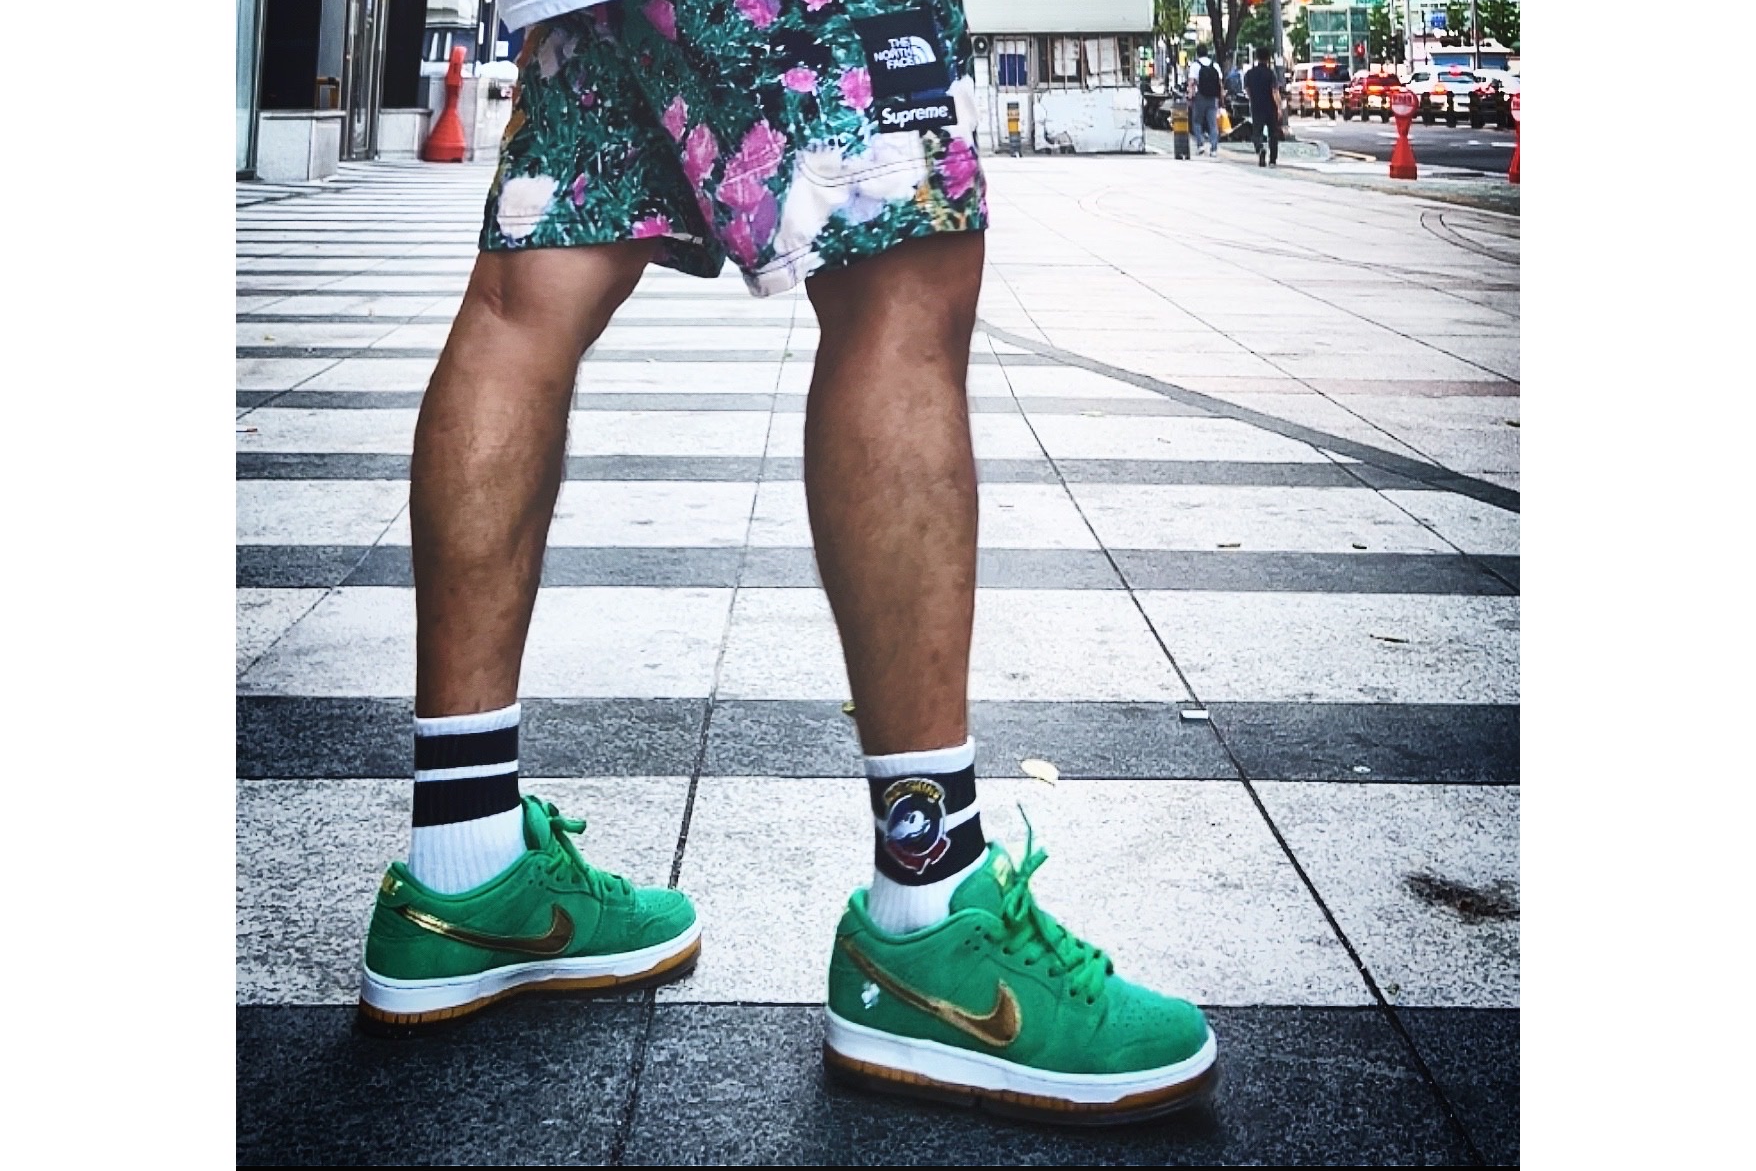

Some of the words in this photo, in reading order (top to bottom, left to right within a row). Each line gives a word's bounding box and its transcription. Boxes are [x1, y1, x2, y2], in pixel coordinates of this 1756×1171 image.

[888, 36, 911, 48] THE
[874, 47, 914, 62] NORTH
[886, 58, 915, 70] FACE
[881, 105, 949, 128] Supreme
